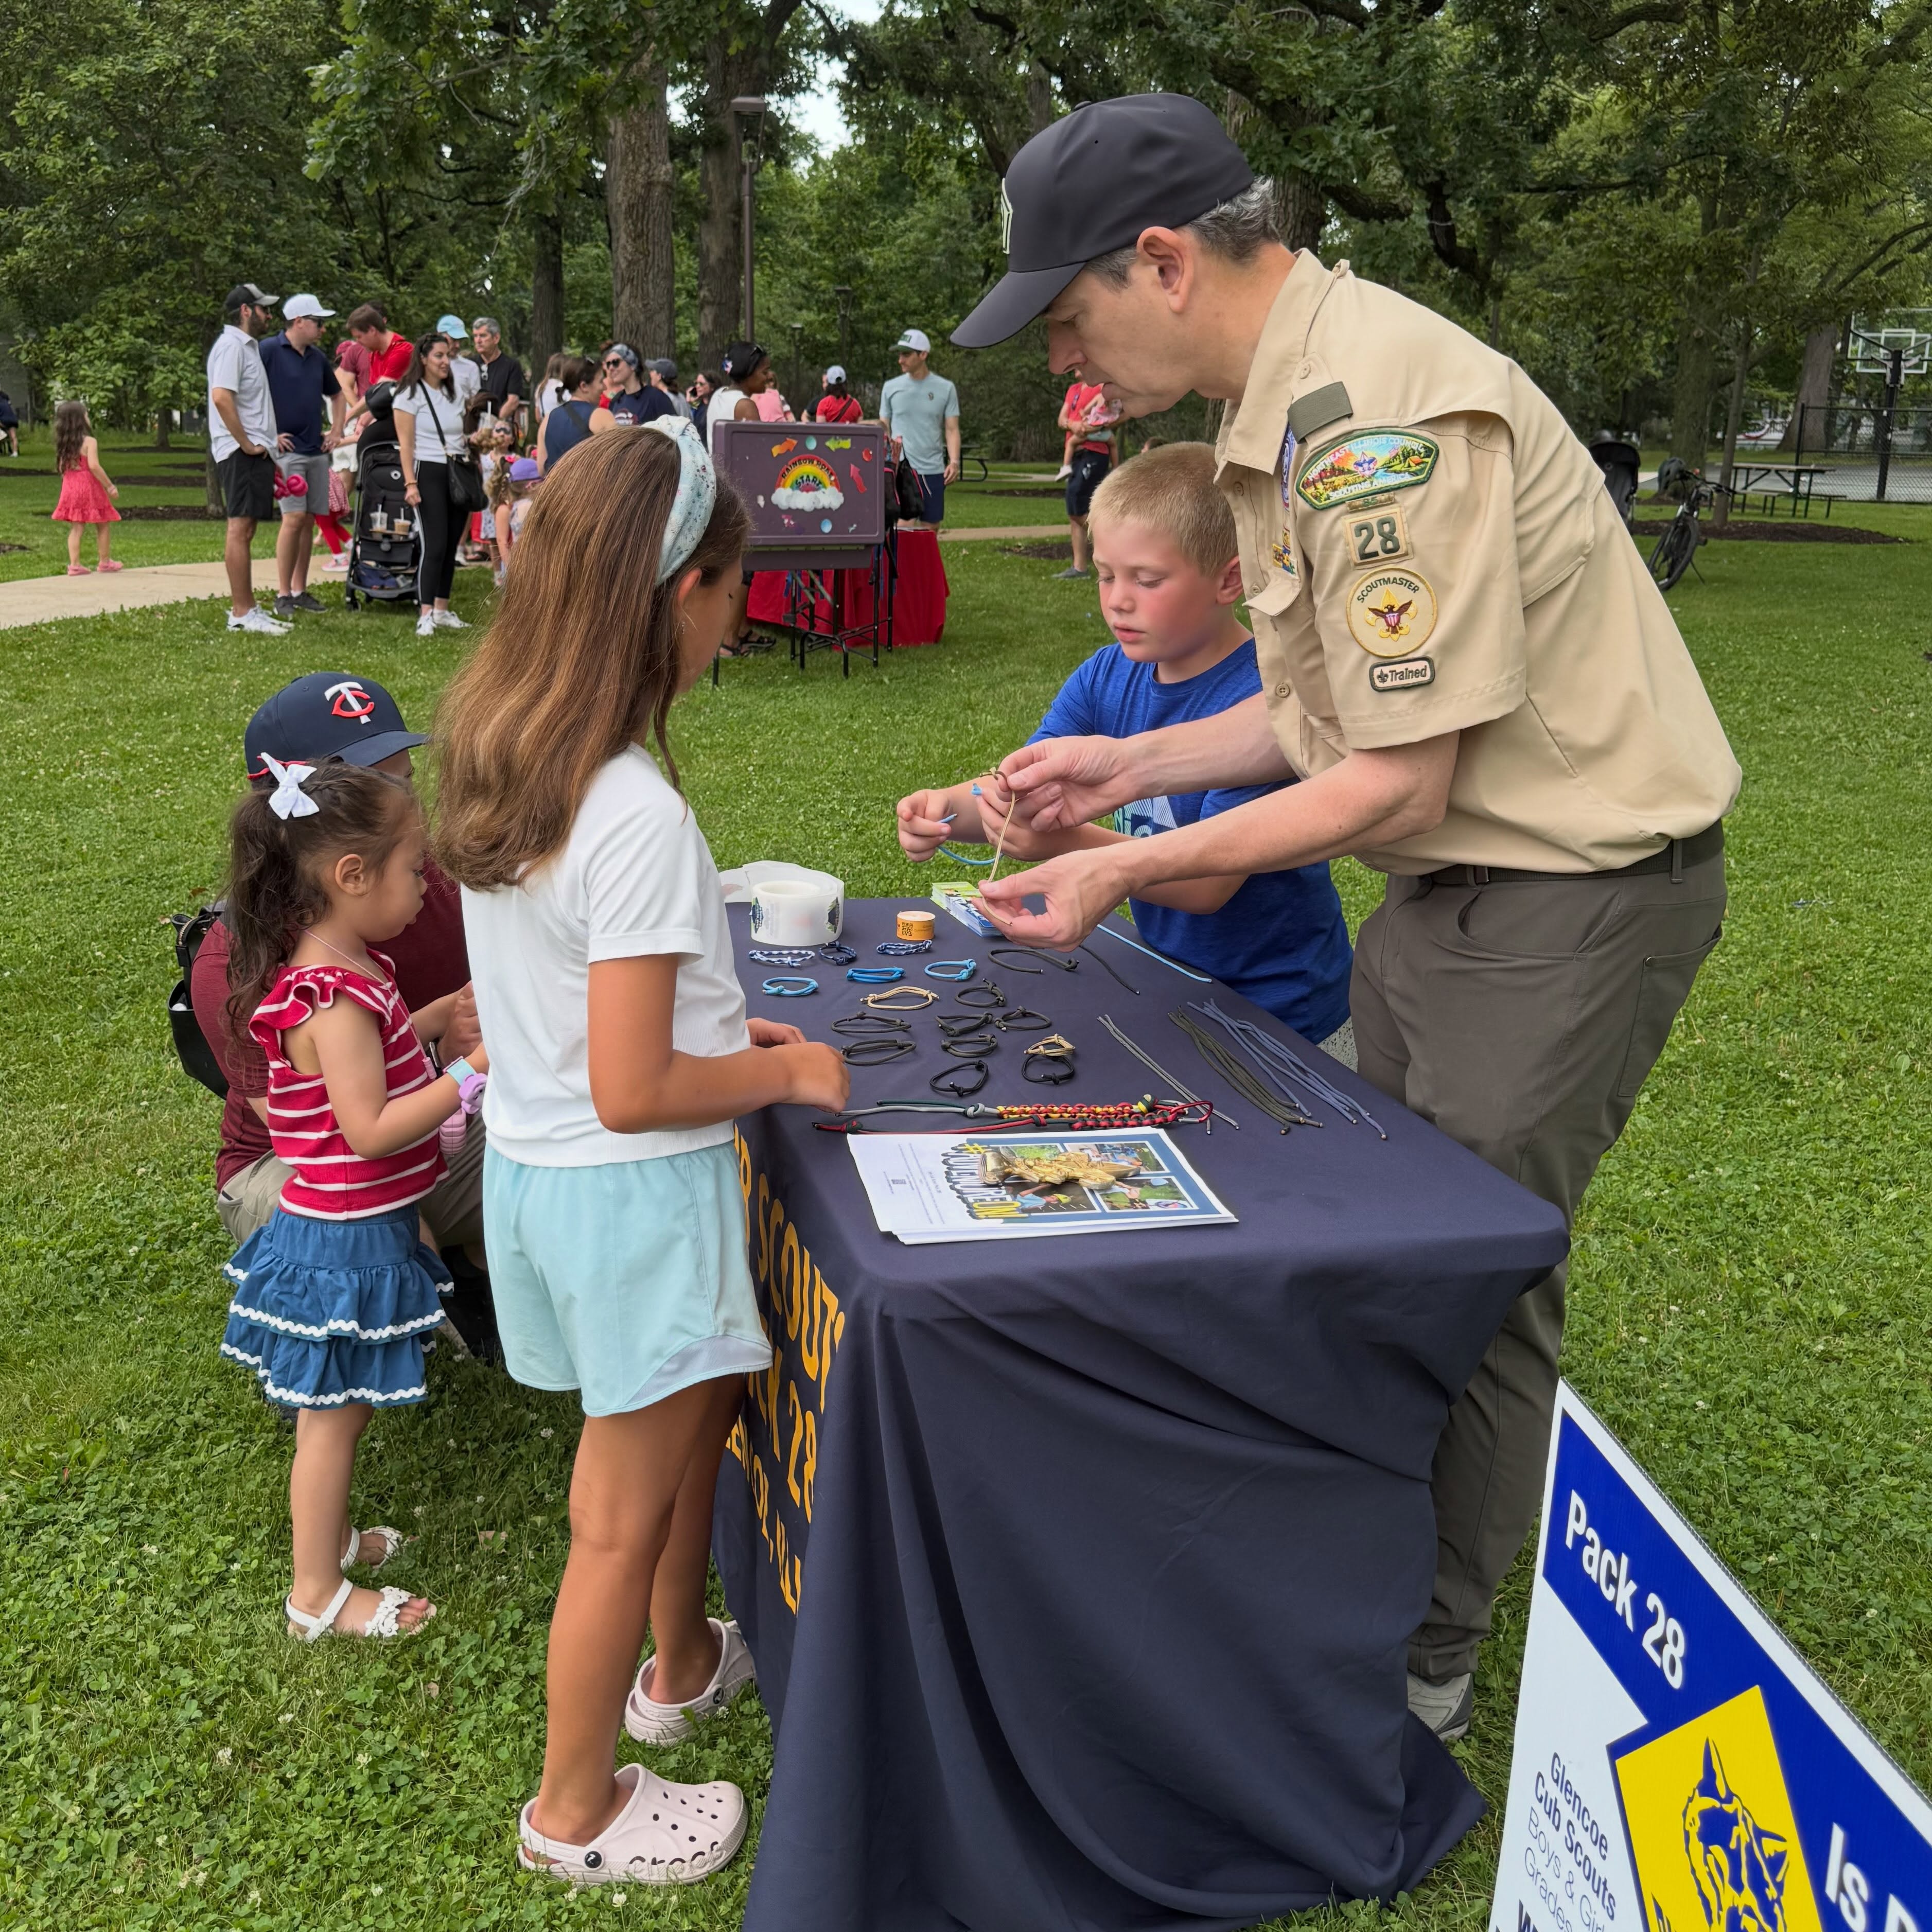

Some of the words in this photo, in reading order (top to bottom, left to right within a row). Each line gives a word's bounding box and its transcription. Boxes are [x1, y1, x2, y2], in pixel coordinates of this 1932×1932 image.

[781, 458, 814, 479] RAINBOW
[795, 474, 822, 487] START
[1308, 443, 1349, 481] NORTHEAST
[1350, 437, 1387, 450] ILLINOIS
[1390, 436, 1427, 451] COUNCIL
[1329, 480, 1371, 500] SCOUTING
[1372, 471, 1411, 487] AMERICA
[1354, 516, 1400, 560] 28
[1357, 576, 1420, 603] SCOUTMASTER
[1389, 665, 1428, 682] Trained
[787, 1380, 817, 1524] 28
[1565, 1488, 1638, 1632] Pack
[1642, 1592, 1685, 1689] 28
[1825, 1822, 1868, 1932] Is
[1551, 1752, 1608, 1861] Glencoe
[1529, 1806, 1561, 1879] Boys
[1565, 1870, 1574, 1905] &
[1535, 1771, 1561, 1832] Cub
[1565, 1819, 1616, 1921] Scouts
